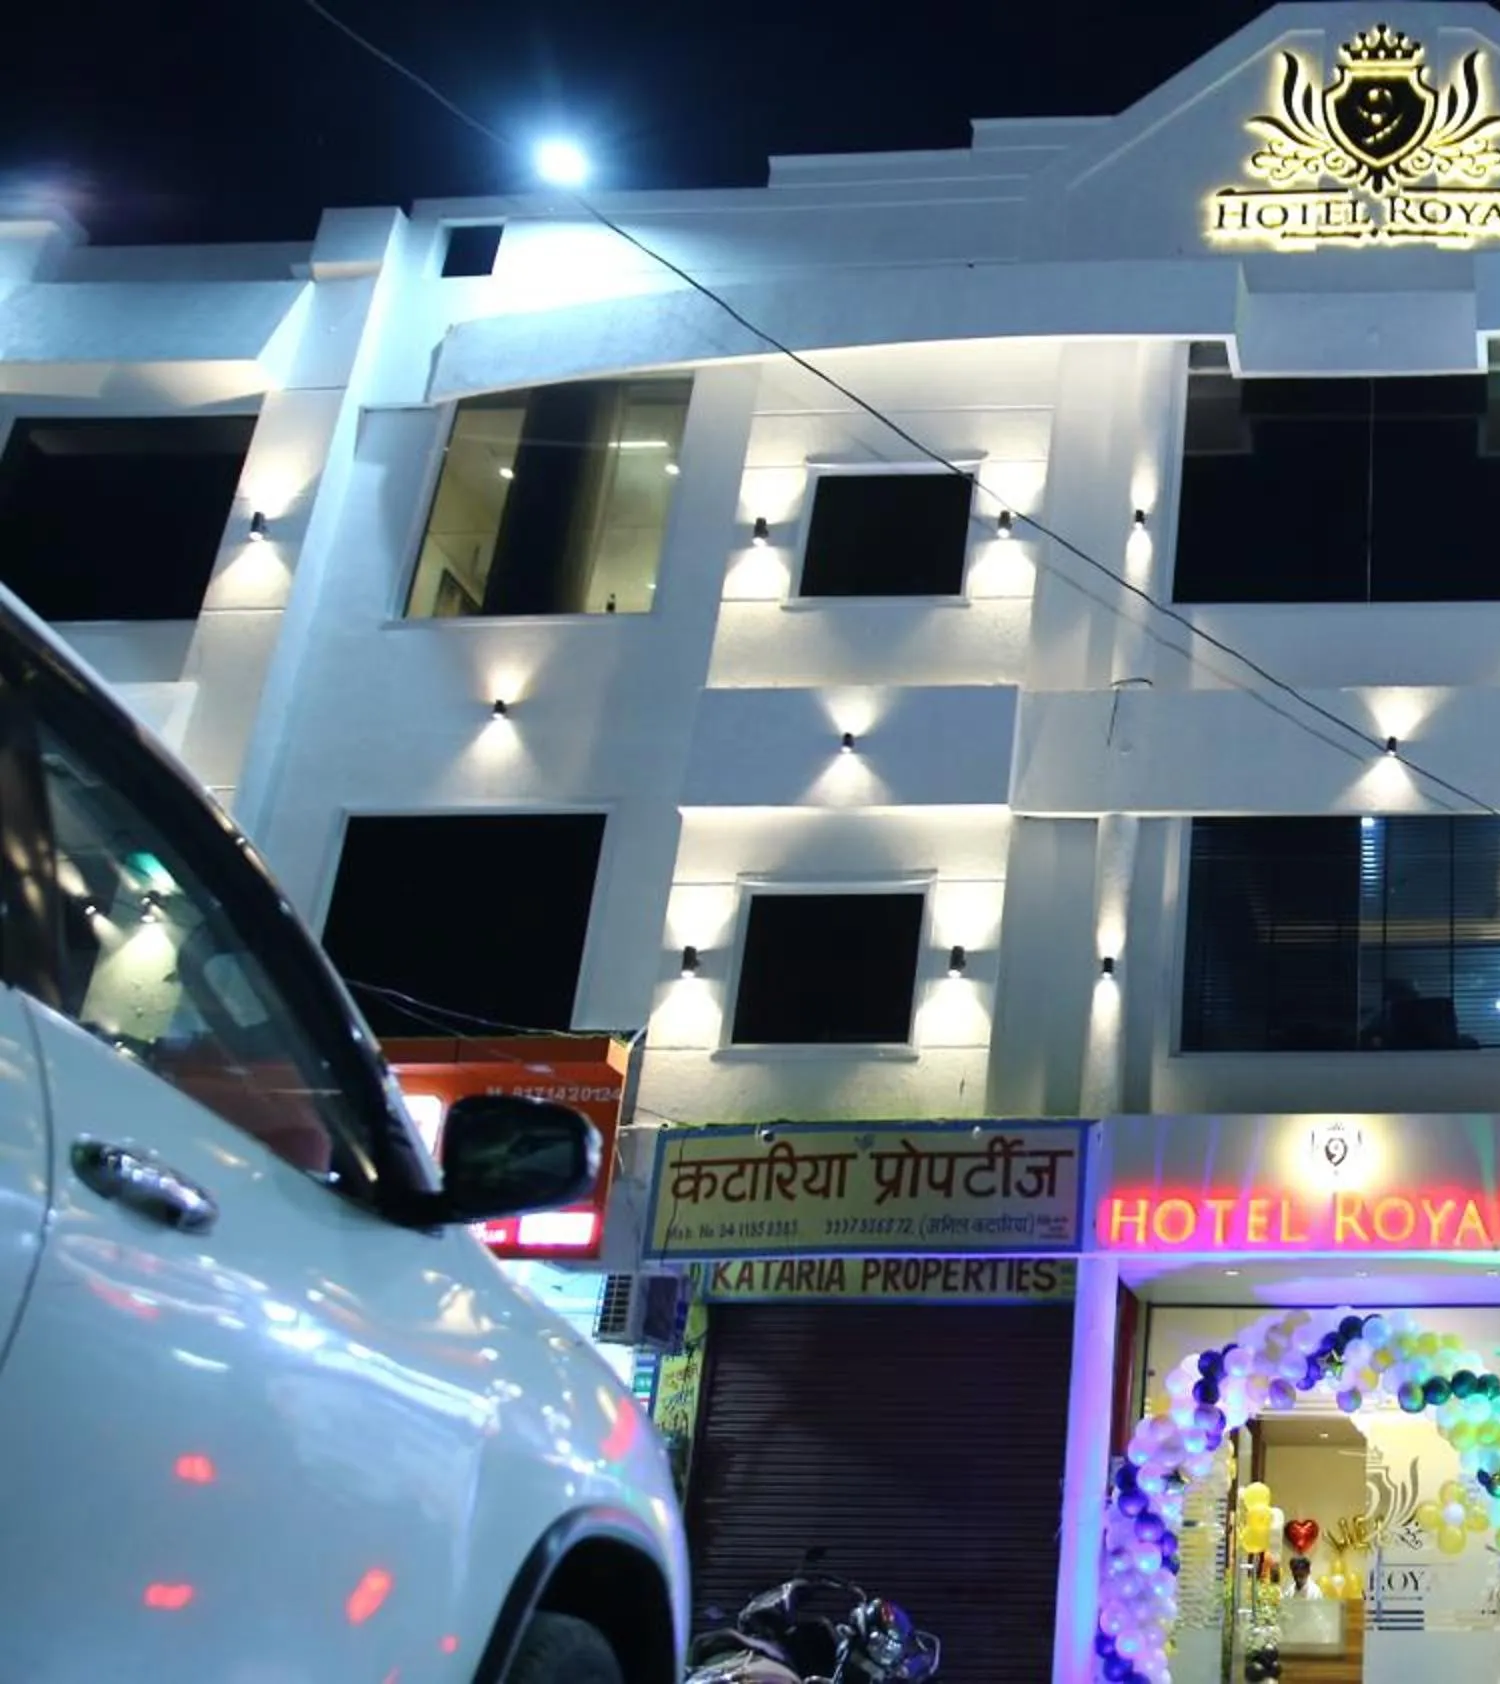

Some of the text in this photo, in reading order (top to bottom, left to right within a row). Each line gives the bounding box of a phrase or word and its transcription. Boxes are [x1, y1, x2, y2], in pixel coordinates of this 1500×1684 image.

[1216, 199, 1372, 230] HOTEL
[670, 1136, 1075, 1205] कटारिया प्रोपर्टीज
[1111, 1197, 1309, 1244] HOTEL
[710, 1257, 1058, 1293] KATARIA PROPERTIES
